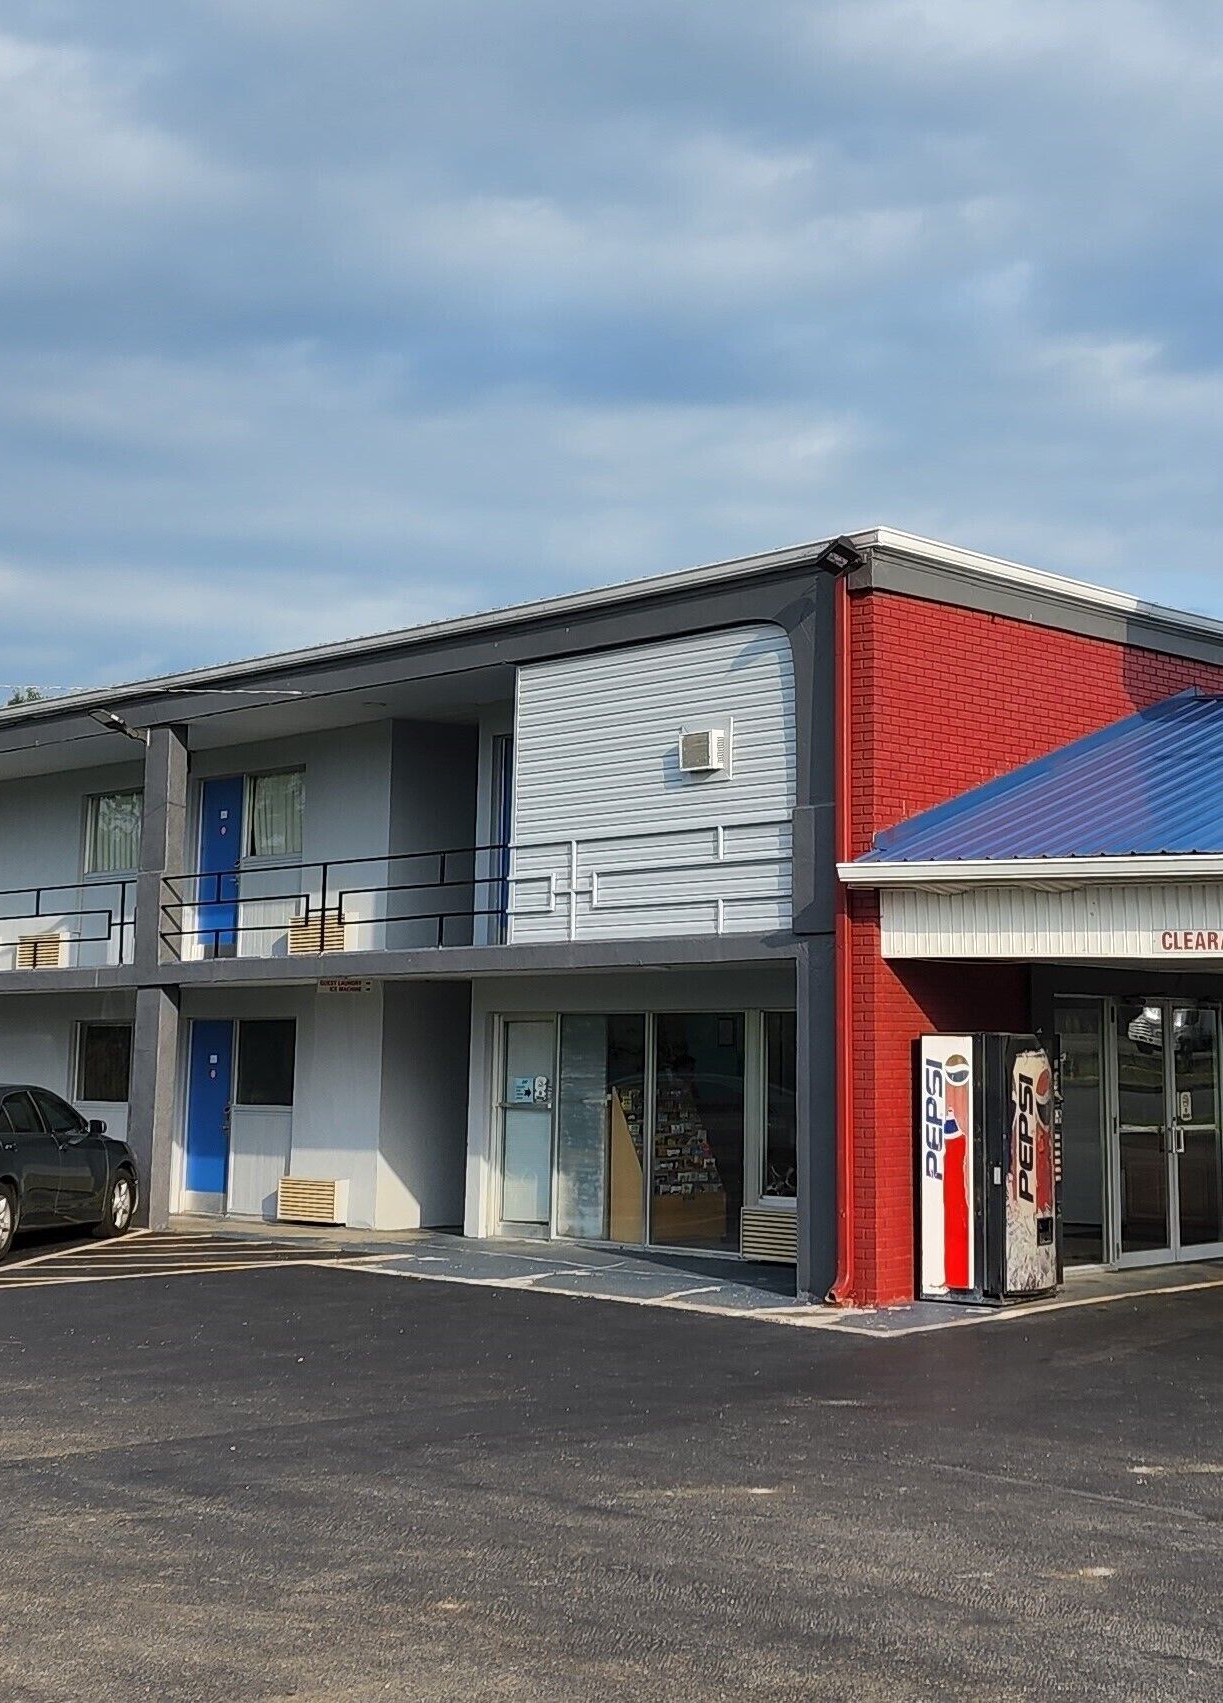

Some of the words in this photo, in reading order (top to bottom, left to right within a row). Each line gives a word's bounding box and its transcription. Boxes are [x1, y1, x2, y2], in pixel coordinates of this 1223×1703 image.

[1161, 931, 1223, 951] CLEAR
[925, 1057, 943, 1181] PEPSI
[1018, 1072, 1034, 1204] PEPSI
